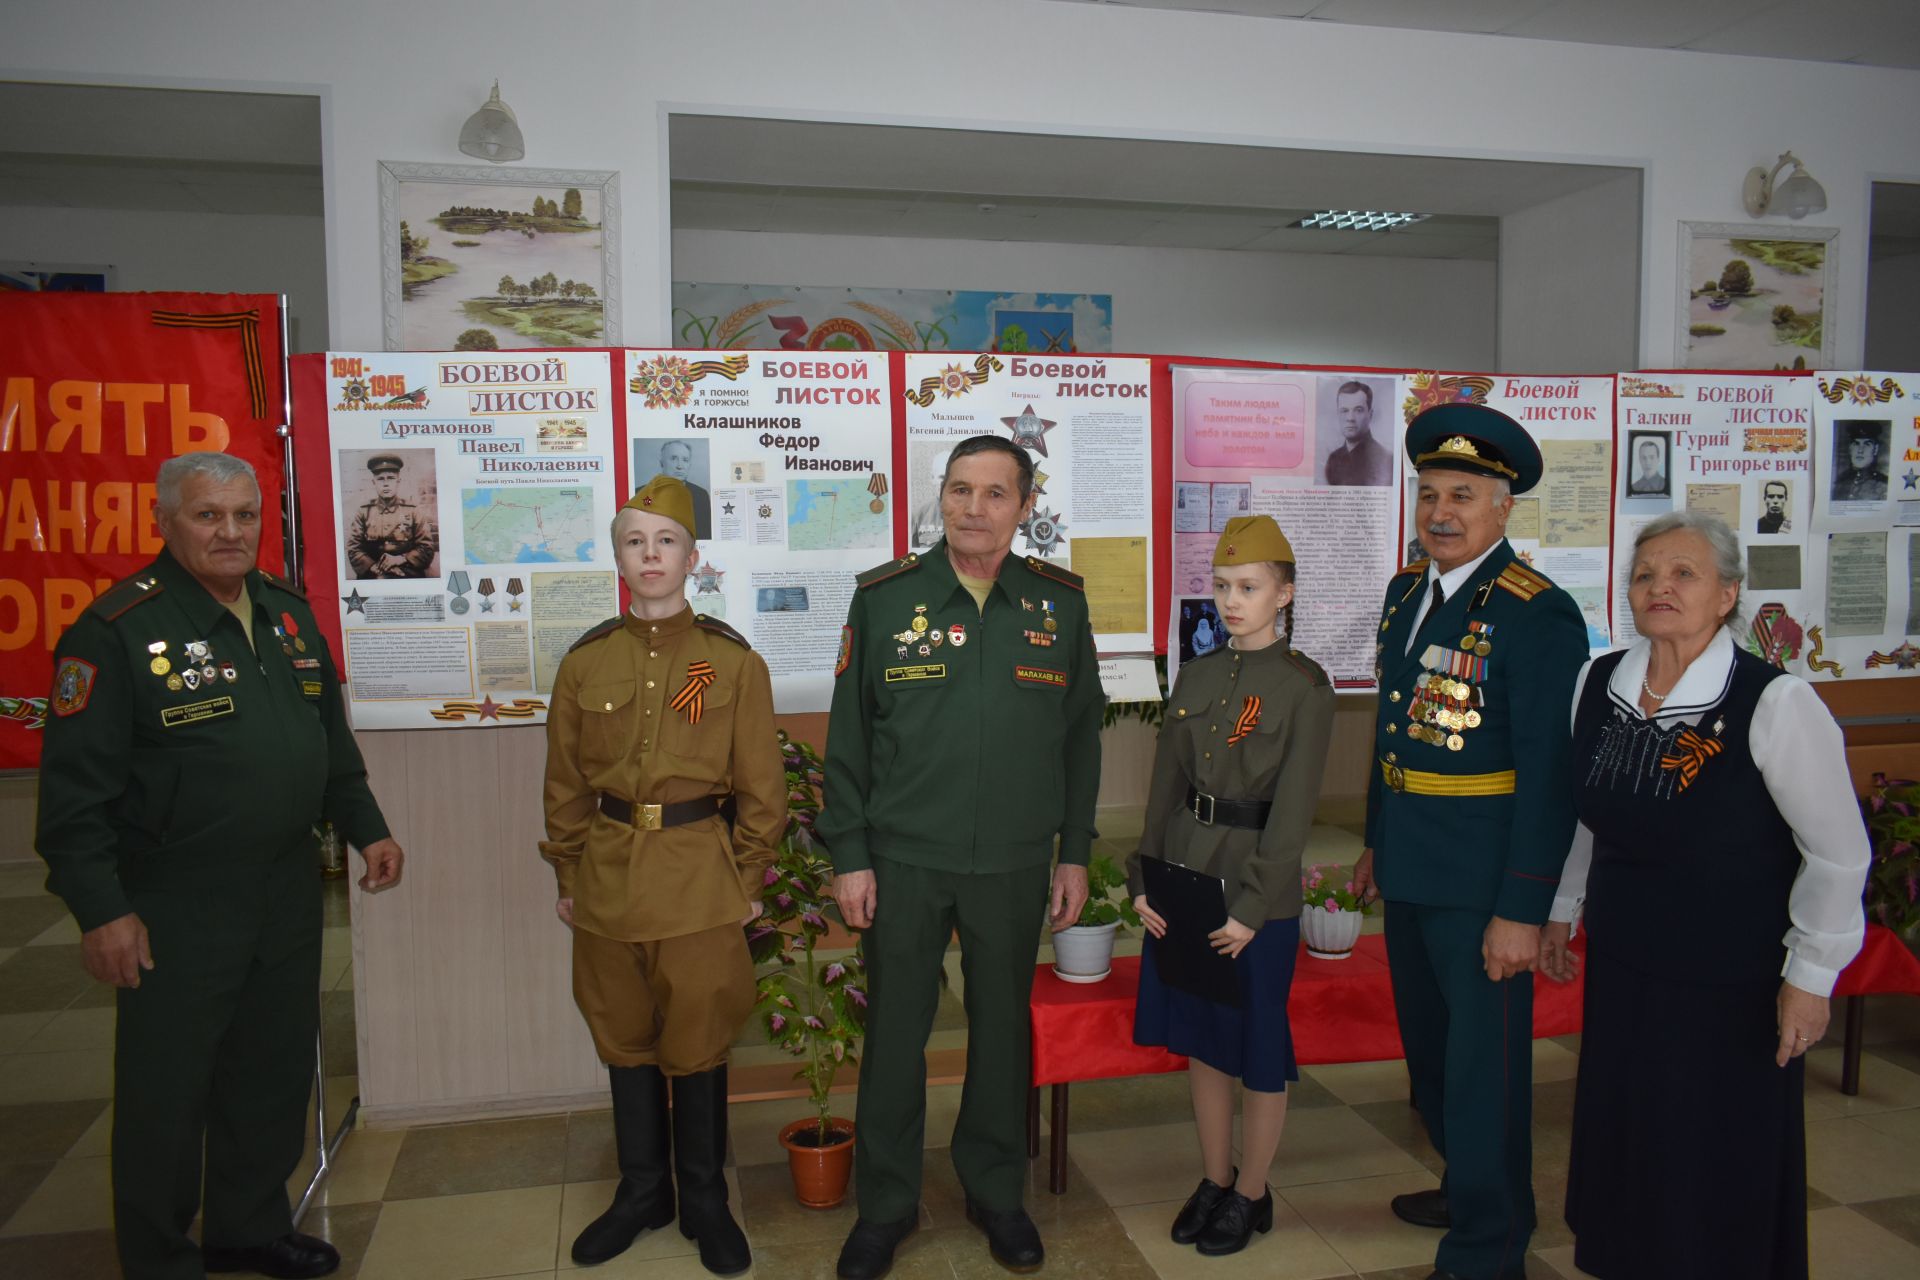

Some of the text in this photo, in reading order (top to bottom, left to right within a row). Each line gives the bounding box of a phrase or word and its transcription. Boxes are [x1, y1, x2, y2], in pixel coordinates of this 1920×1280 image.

[331, 357, 371, 378] 1941-
[441, 358, 565, 384] БОЕВОЙ
[762, 359, 868, 380] БОЕВОЙ
[1010, 358, 1107, 378] Боевой
[369, 374, 405, 397] 1945
[710, 389, 749, 397] ПОМНЮ!
[1056, 382, 1148, 398] листок
[1504, 379, 1579, 399] Боевой
[1697, 384, 1774, 403] БОЕВОЙ
[471, 390, 596, 413] ЛИСТОК
[775, 387, 881, 405] ЛИСТОК
[684, 413, 801, 429] Калашников
[931, 412, 975, 421] Малышев
[1519, 406, 1597, 421] листок
[1626, 408, 1692, 425] Галкин
[1726, 408, 1808, 424] ЛИСТОК
[384, 420, 493, 438] Артамонов
[909, 426, 995, 437] Евгений Данилович
[462, 439, 520, 453] Павел
[759, 432, 820, 451] Фёдор
[1676, 430, 1730, 451] Гурий
[482, 458, 600, 472] Николаевич
[785, 455, 874, 472] Иванович
